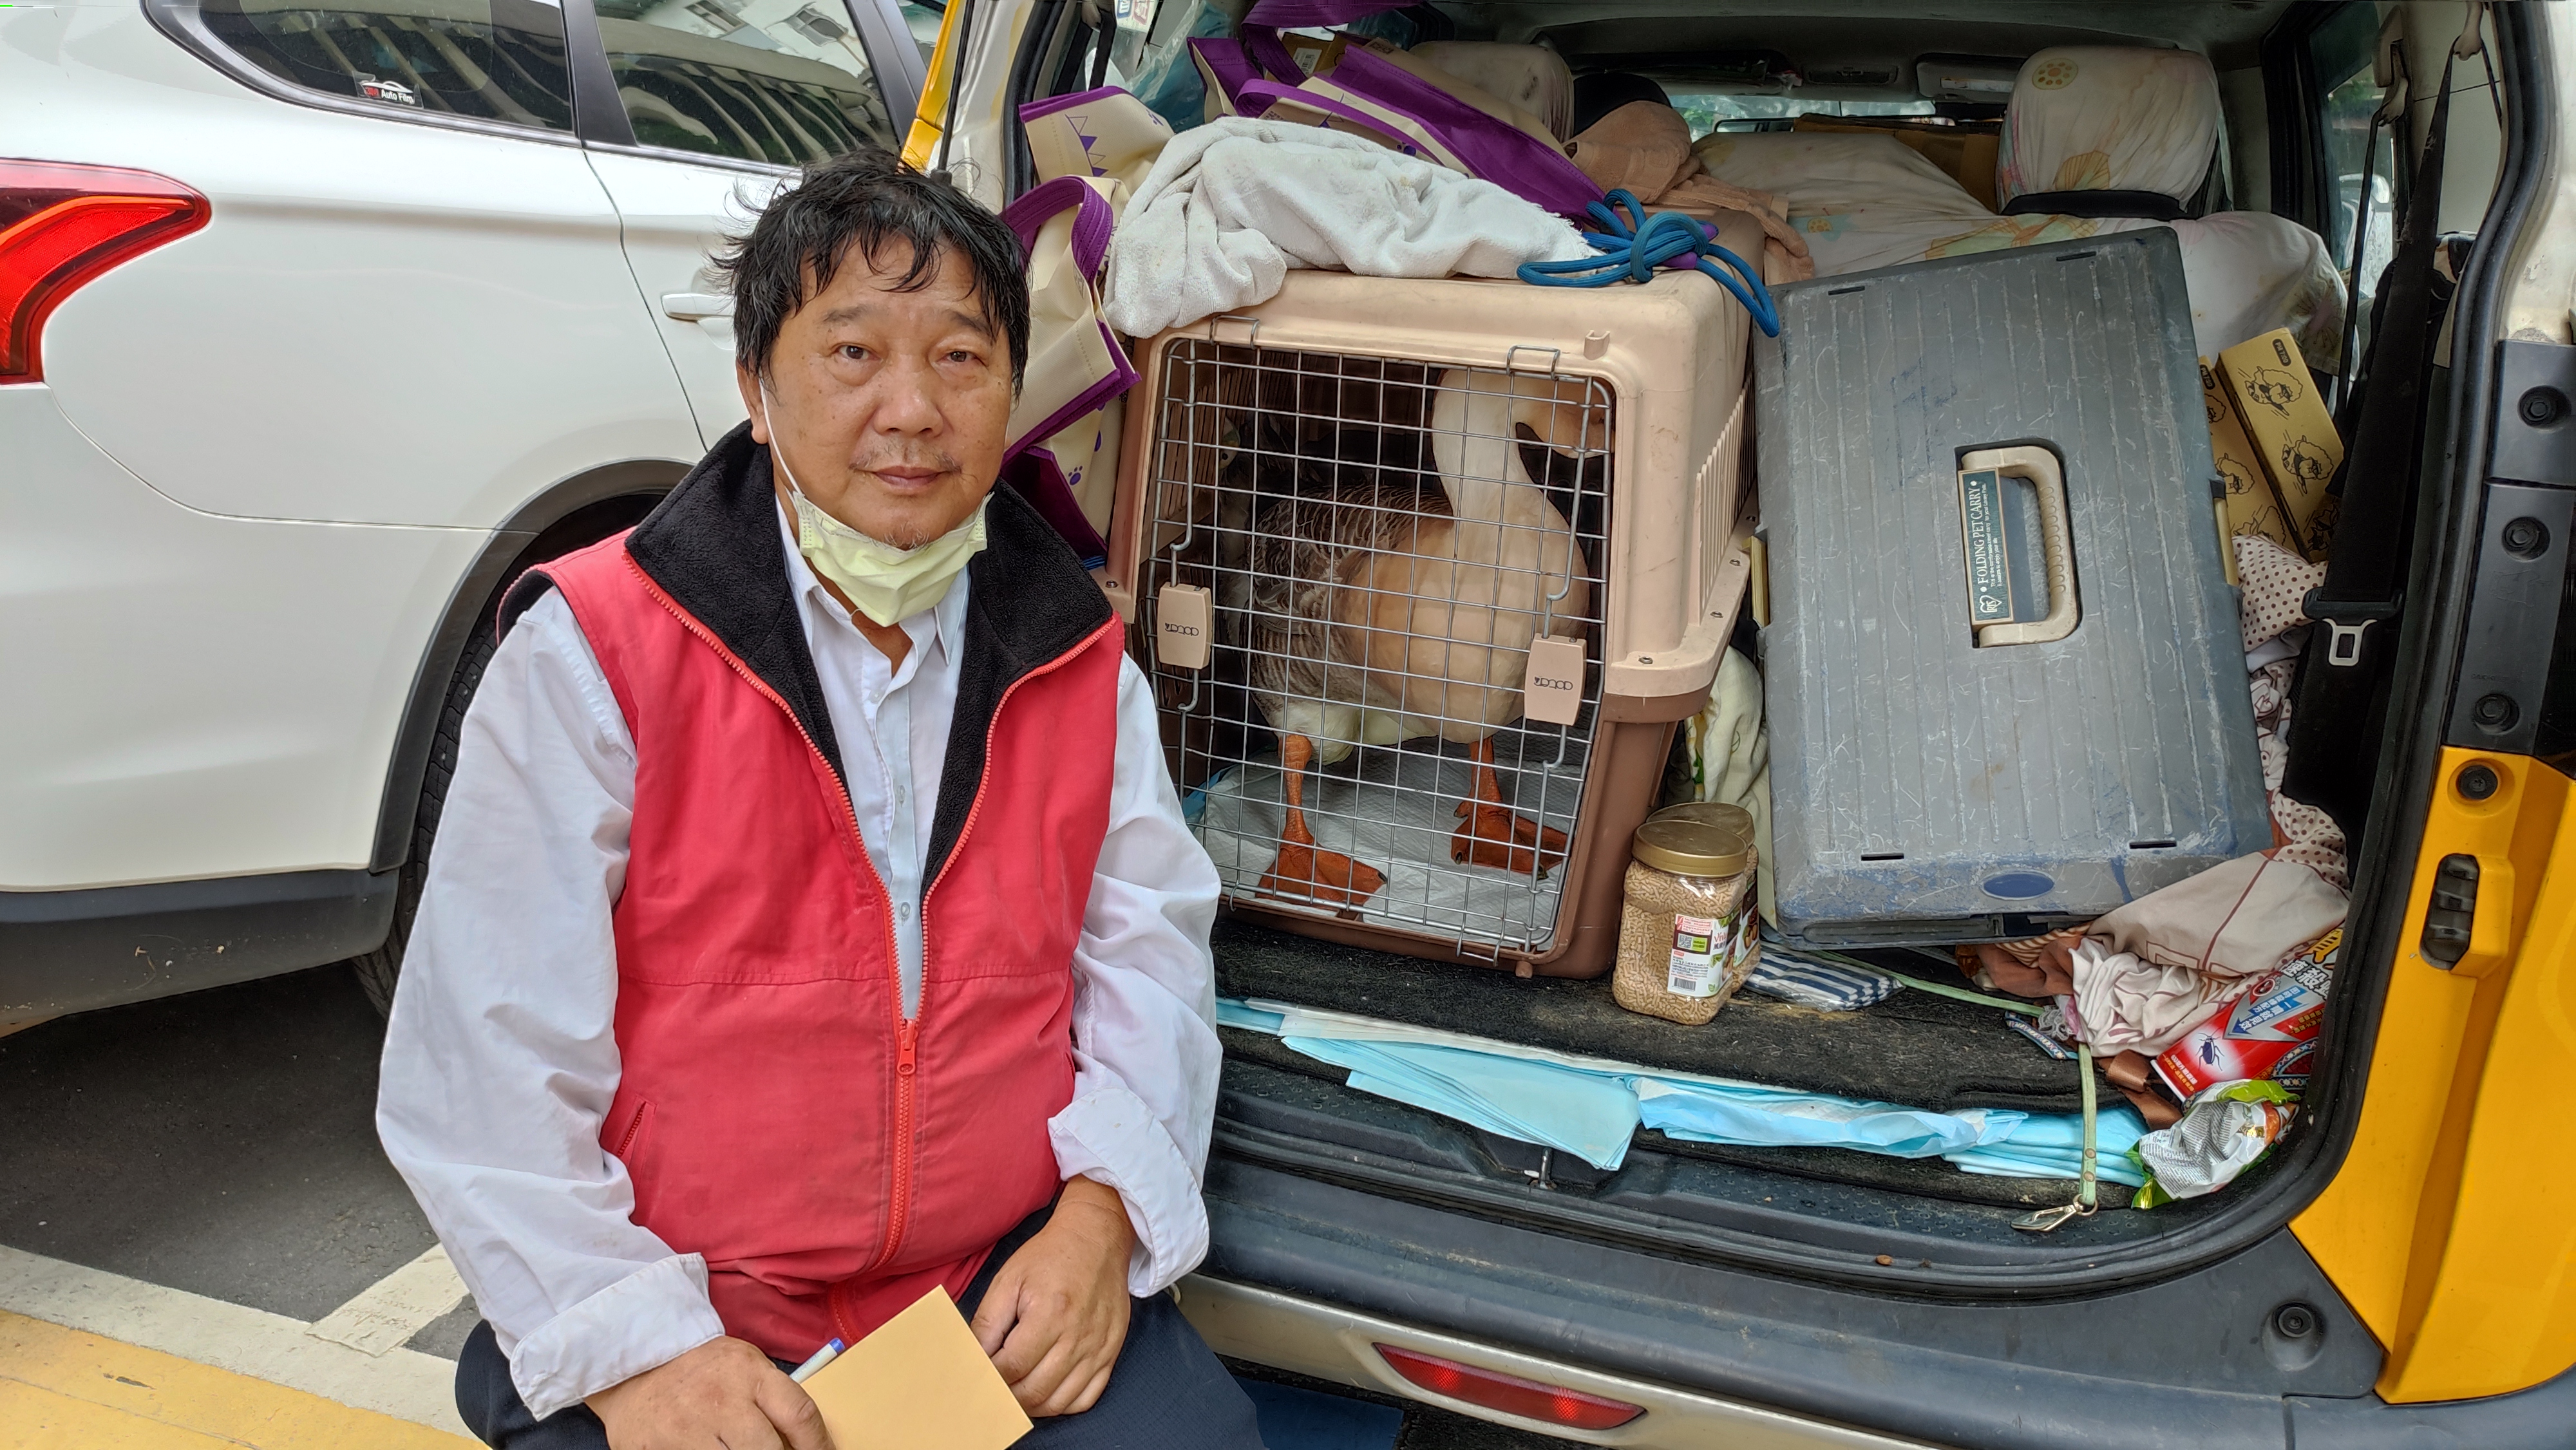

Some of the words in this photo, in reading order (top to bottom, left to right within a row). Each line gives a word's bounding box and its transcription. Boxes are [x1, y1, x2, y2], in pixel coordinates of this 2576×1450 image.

[381, 89, 398, 100] Auto
[398, 92, 415, 104] Film
[2275, 341, 2283, 352] PM
[2280, 351, 2289, 363] 7:00
[1968, 487, 1983, 520] CARRY
[1971, 520, 1985, 538] PET
[1973, 540, 1989, 585] FOLDING
